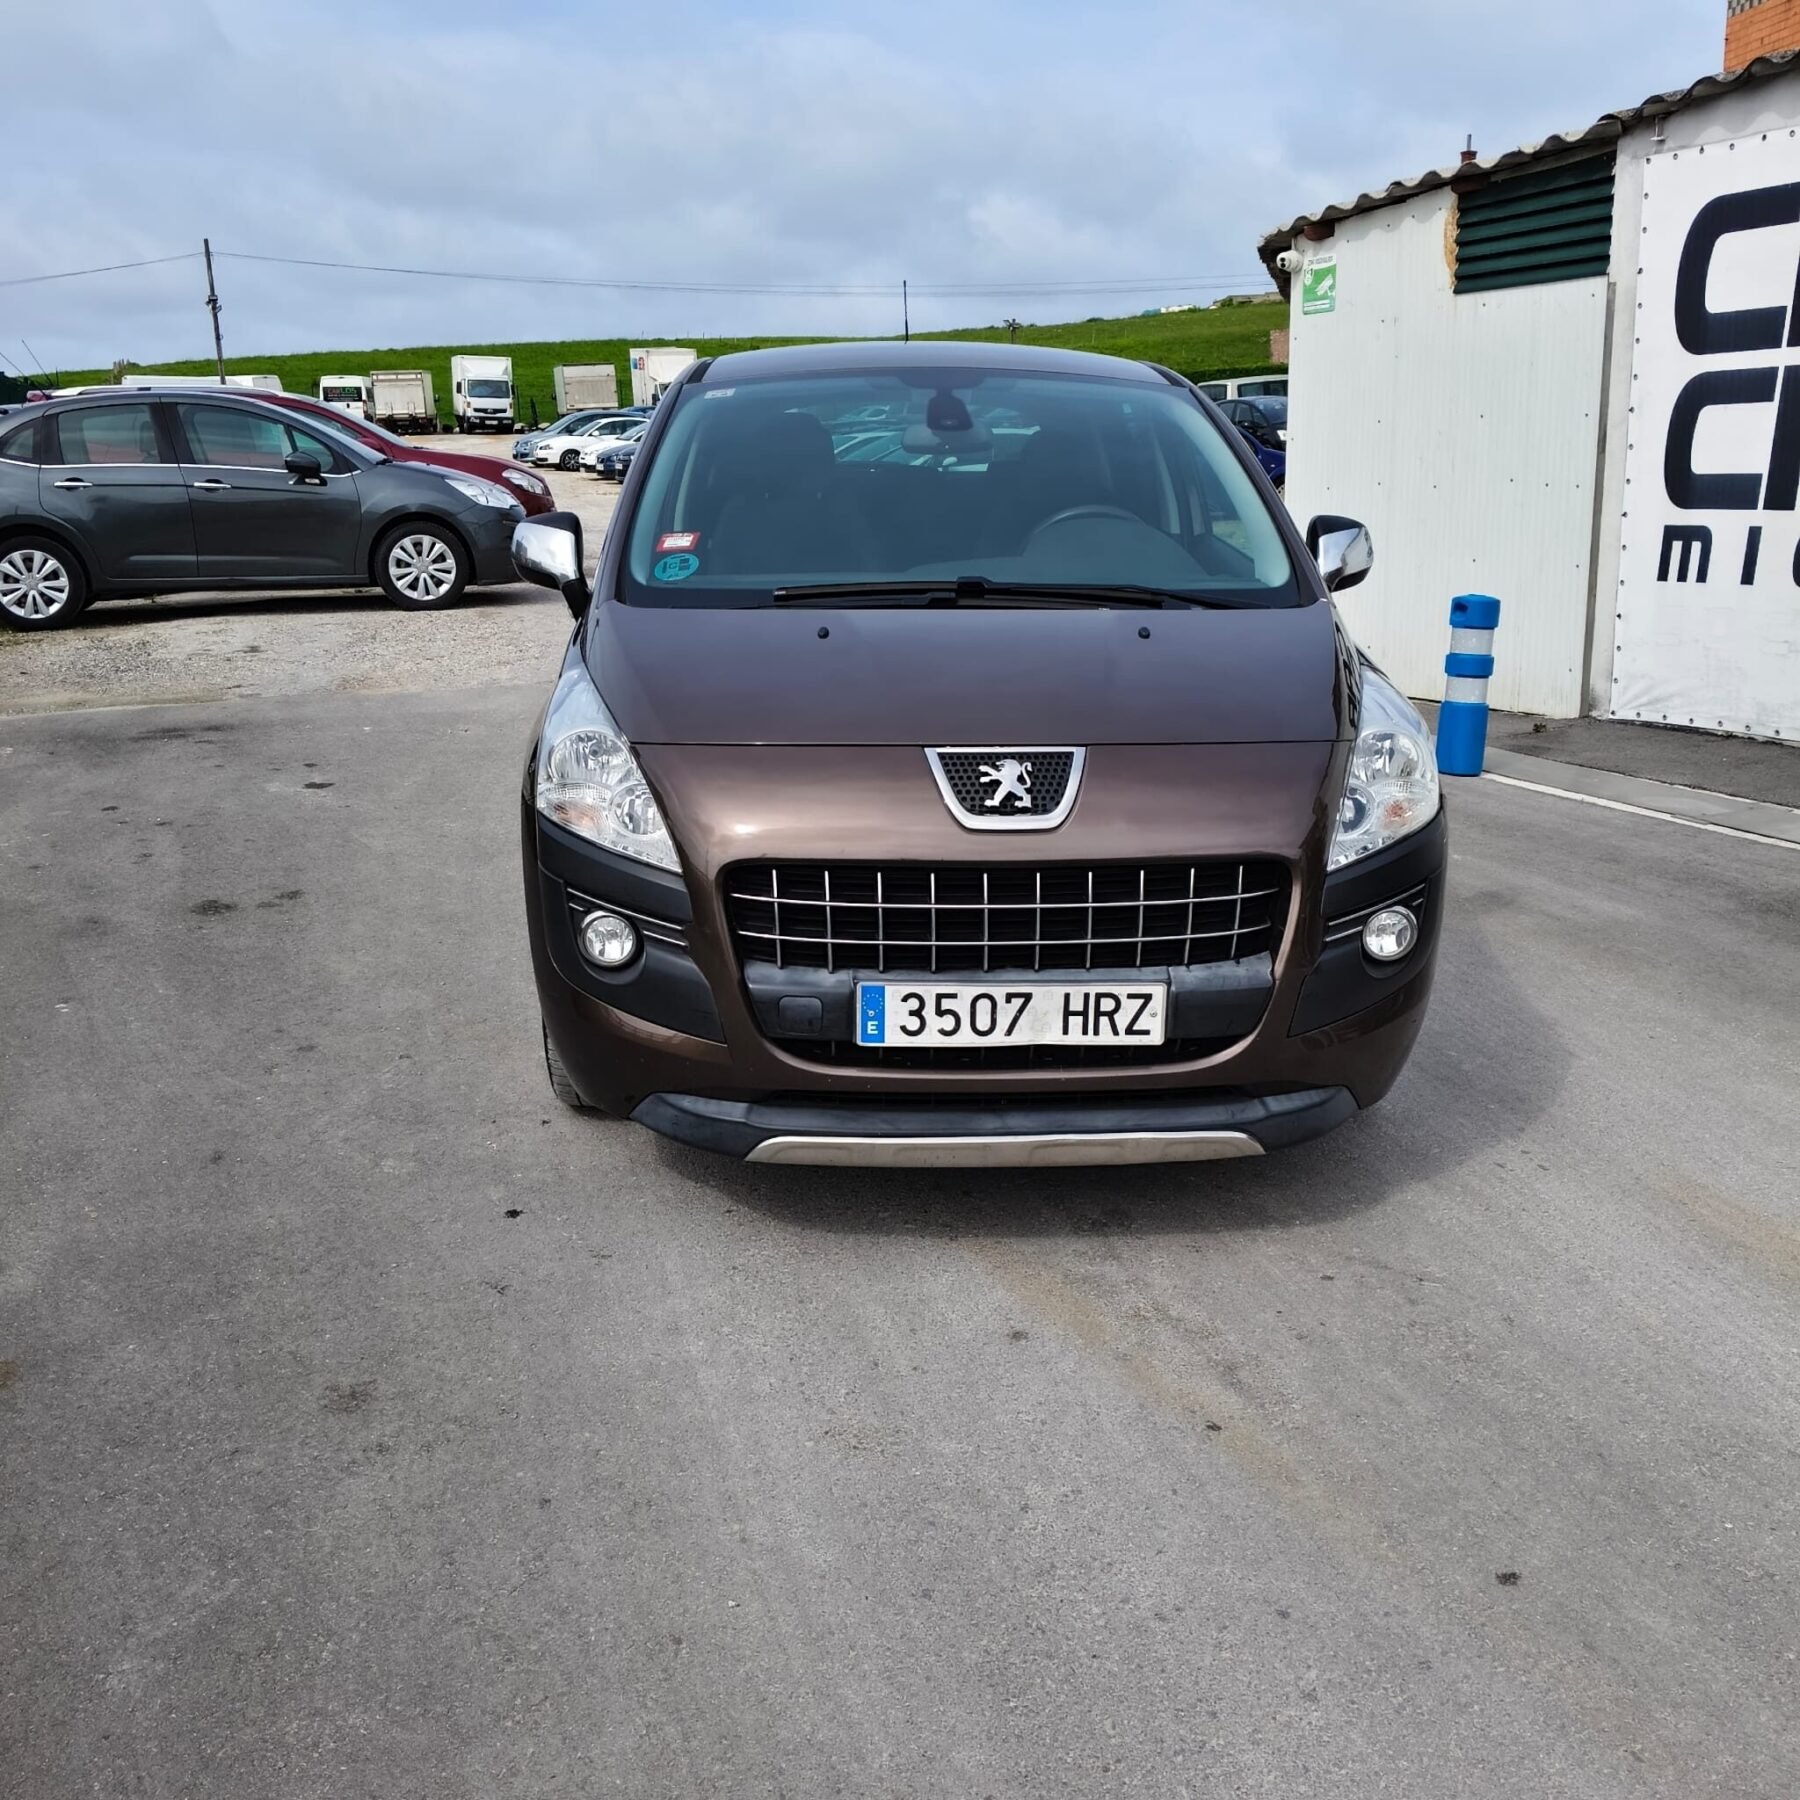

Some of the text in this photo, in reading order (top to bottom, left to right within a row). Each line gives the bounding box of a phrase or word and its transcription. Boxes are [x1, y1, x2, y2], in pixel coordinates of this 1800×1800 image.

[1657, 525, 1800, 588] MI
[867, 1021, 879, 1034] E
[900, 992, 1153, 1037] 3507 HRZ
